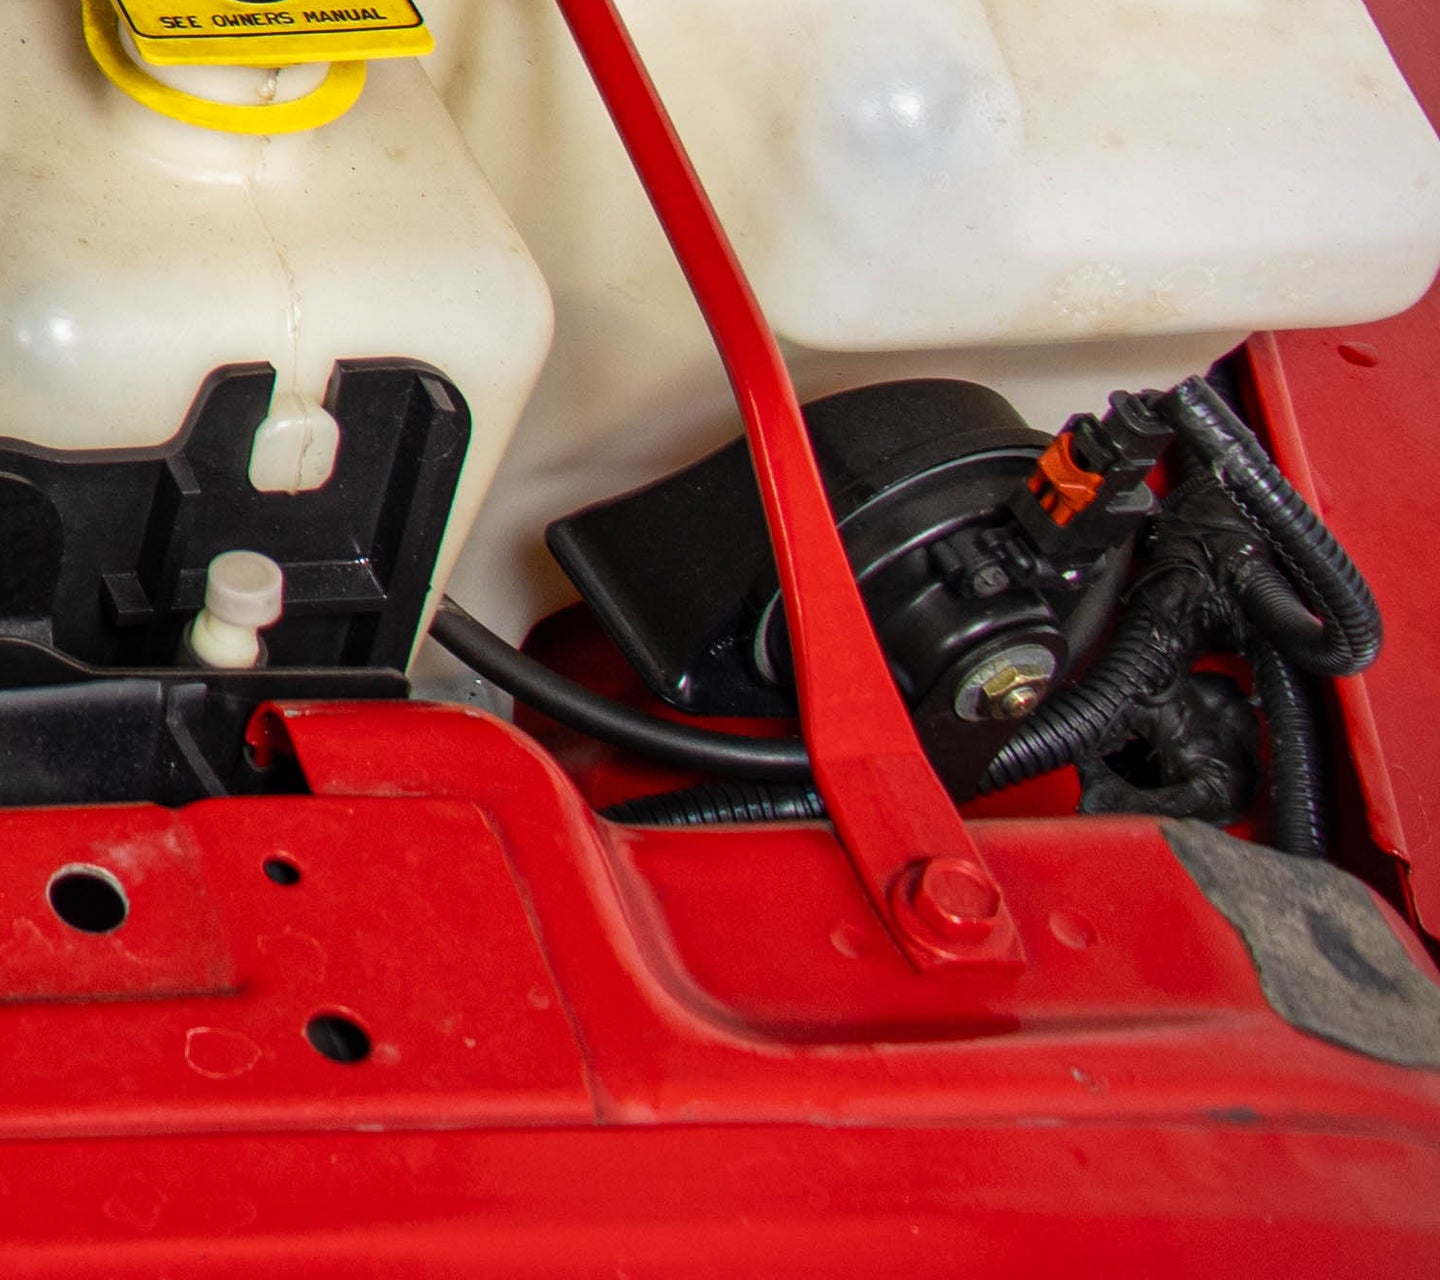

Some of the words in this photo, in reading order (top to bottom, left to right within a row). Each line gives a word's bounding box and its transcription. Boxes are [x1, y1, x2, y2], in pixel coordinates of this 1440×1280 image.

[158, 15, 203, 32] SEE
[212, 10, 295, 29] OWNERS
[303, 6, 388, 25] MANUAL
